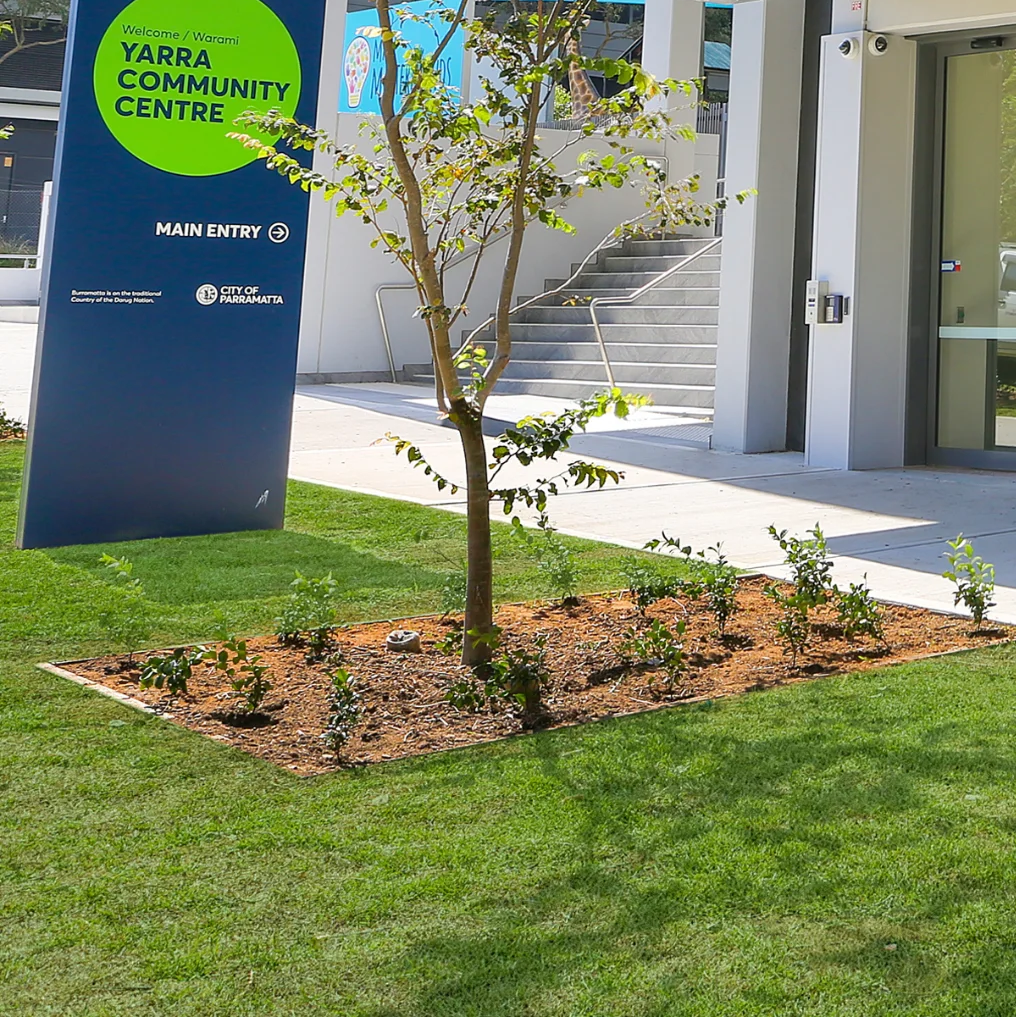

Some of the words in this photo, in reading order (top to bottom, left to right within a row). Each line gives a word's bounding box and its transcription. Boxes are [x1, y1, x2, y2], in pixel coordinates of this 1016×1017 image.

[122, 24, 180, 40] Welcome
[193, 31, 240, 46] Warami
[120, 41, 212, 69] YARRA
[117, 69, 291, 102] COMMUNITY
[115, 95, 224, 123] CENTRE
[155, 222, 203, 237] MAIN
[206, 223, 262, 239] ENTRY
[219, 295, 283, 304] PARRAMATTA
[220, 285, 244, 295] CITY
[244, 286, 259, 295] OF
